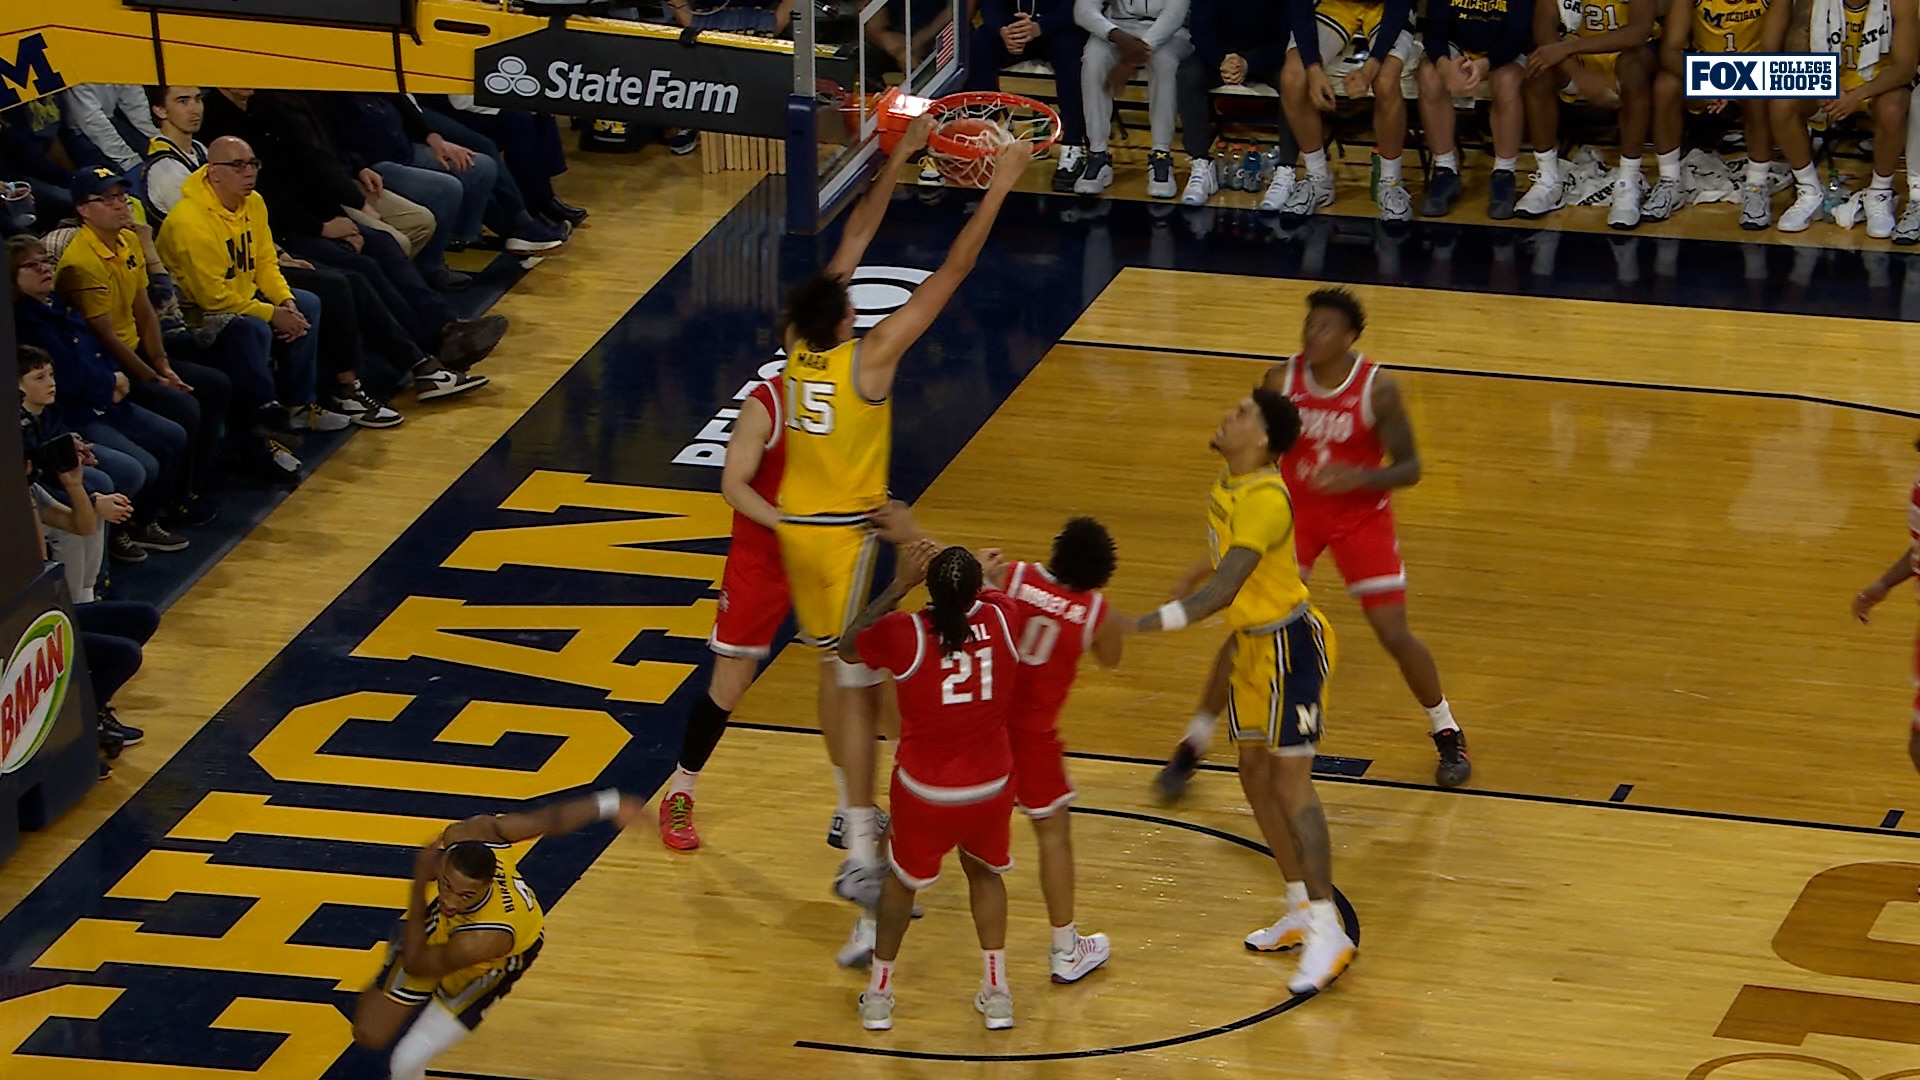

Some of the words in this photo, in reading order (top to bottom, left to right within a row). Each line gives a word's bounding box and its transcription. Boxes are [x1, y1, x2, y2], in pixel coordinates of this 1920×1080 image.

[1584, 5, 1619, 31] 21
[1703, 8, 1762, 28] MICHIGAN
[1723, 33, 1738, 52] 1
[785, 376, 837, 434] 15
[940, 647, 994, 705] 21
